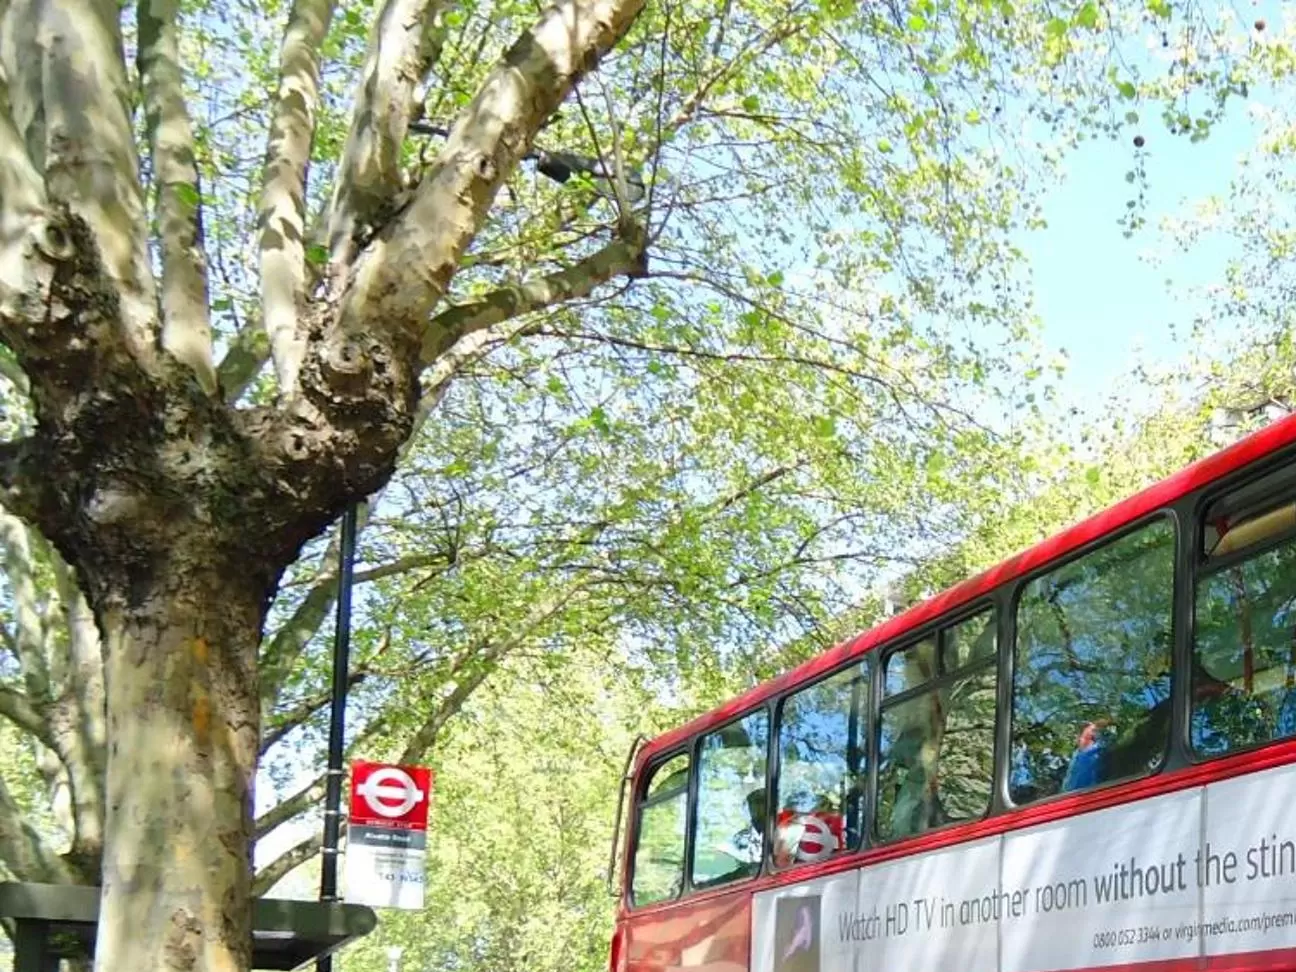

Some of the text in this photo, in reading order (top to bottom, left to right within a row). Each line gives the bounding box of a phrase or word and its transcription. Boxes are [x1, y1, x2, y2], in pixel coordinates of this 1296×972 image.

[838, 906, 881, 943] Watch
[886, 903, 909, 937] HD
[914, 898, 937, 931] TV
[940, 898, 955, 928] in
[960, 887, 1028, 925] another
[1035, 877, 1088, 913] room
[1094, 853, 1187, 904] without
[1194, 843, 1238, 888] the
[1093, 931, 1117, 949] 0800
[1118, 929, 1135, 946] 052
[1137, 927, 1161, 943] 3344
[1162, 927, 1174, 941] or
